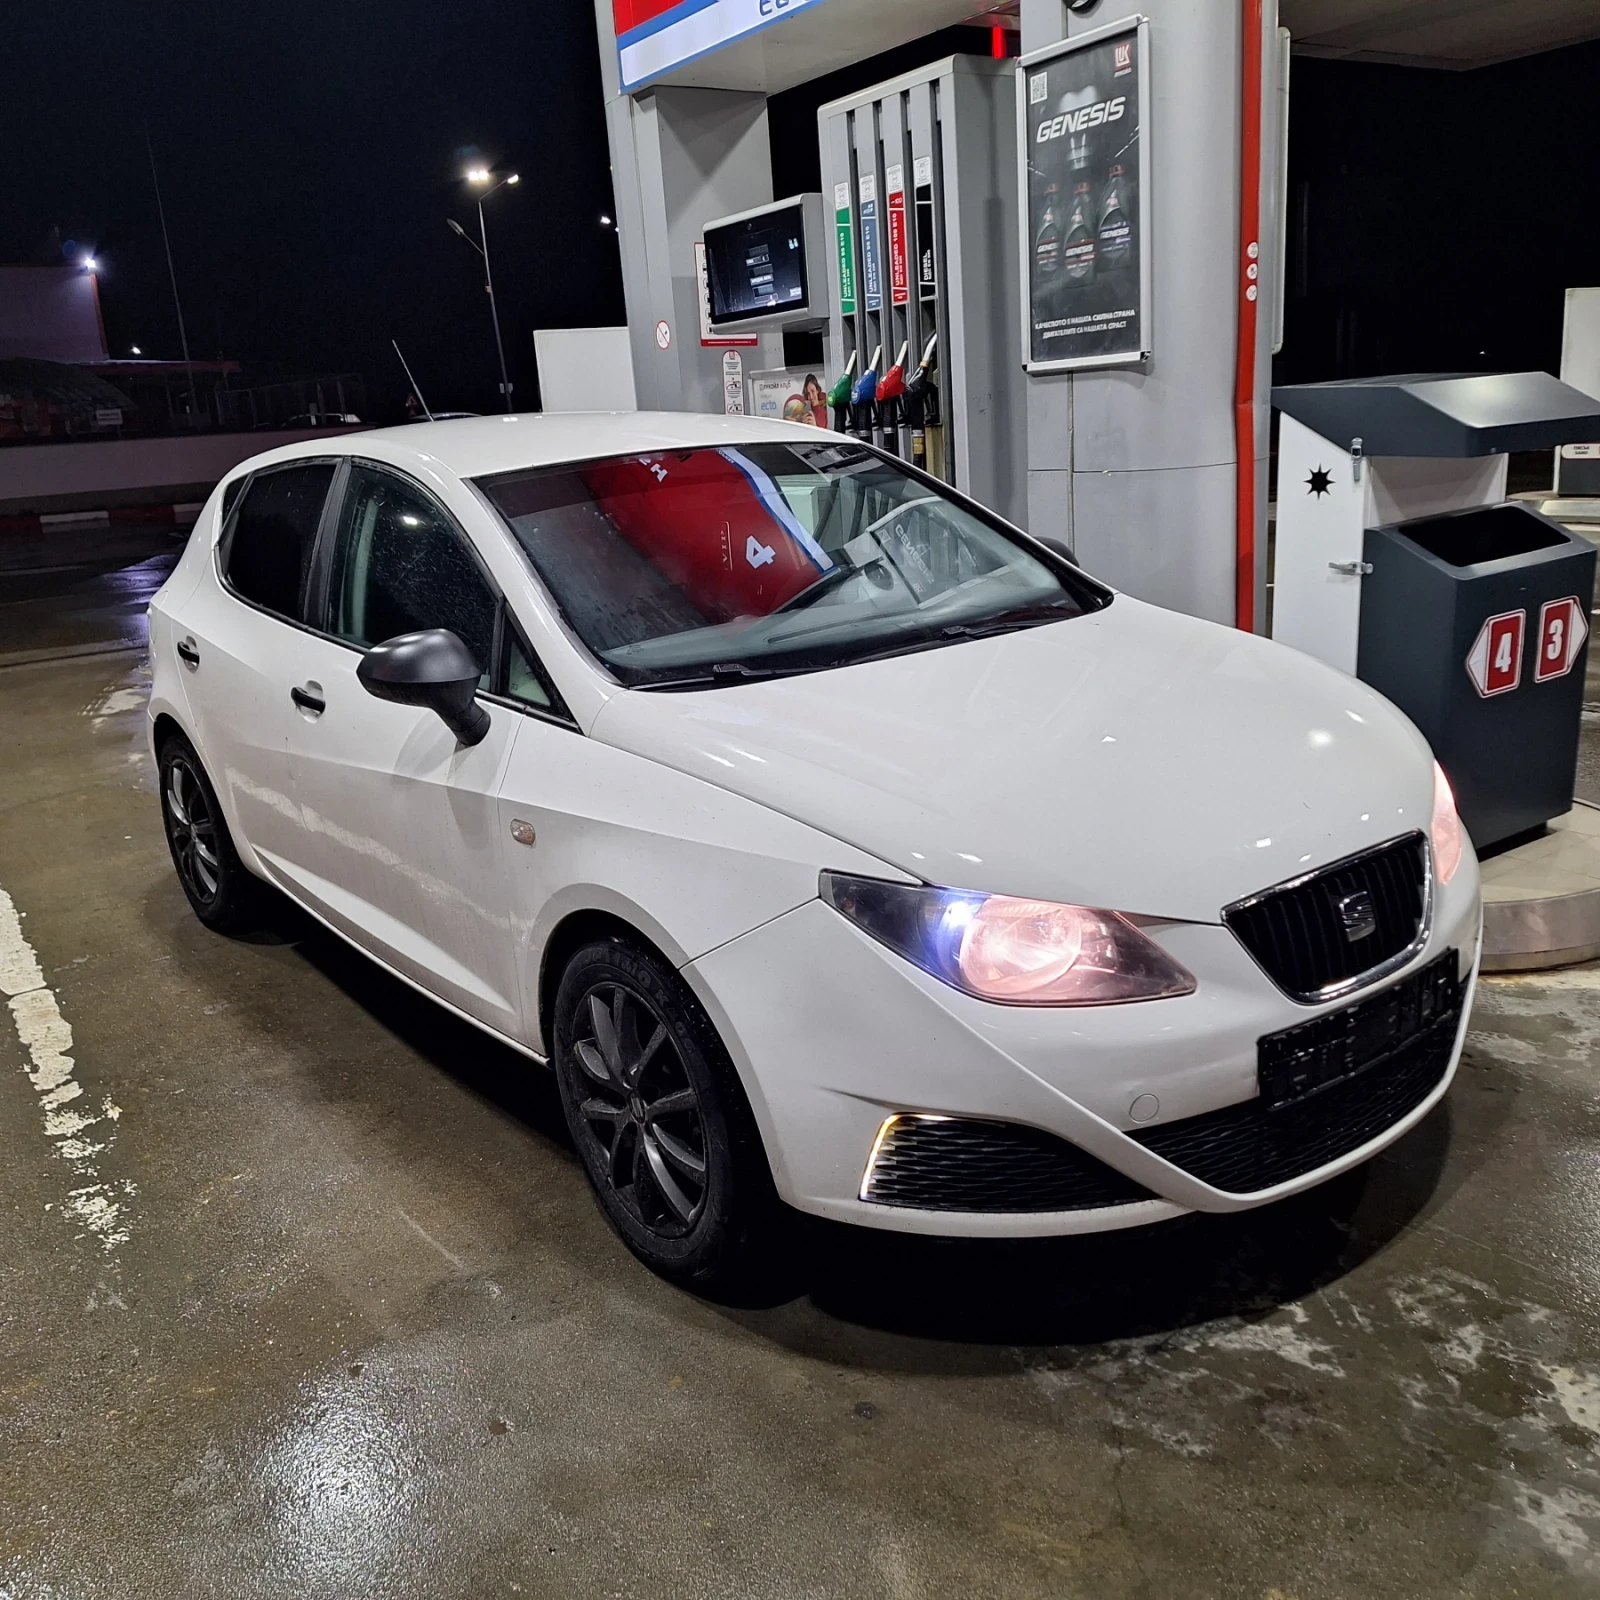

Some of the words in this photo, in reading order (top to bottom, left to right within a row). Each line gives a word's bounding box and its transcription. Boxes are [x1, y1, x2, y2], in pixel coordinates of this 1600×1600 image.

[1036, 96, 1126, 143] GENESIS
[761, 400, 777, 410] ecto
[1494, 632, 1512, 673] 4
[1547, 619, 1563, 660] 3
